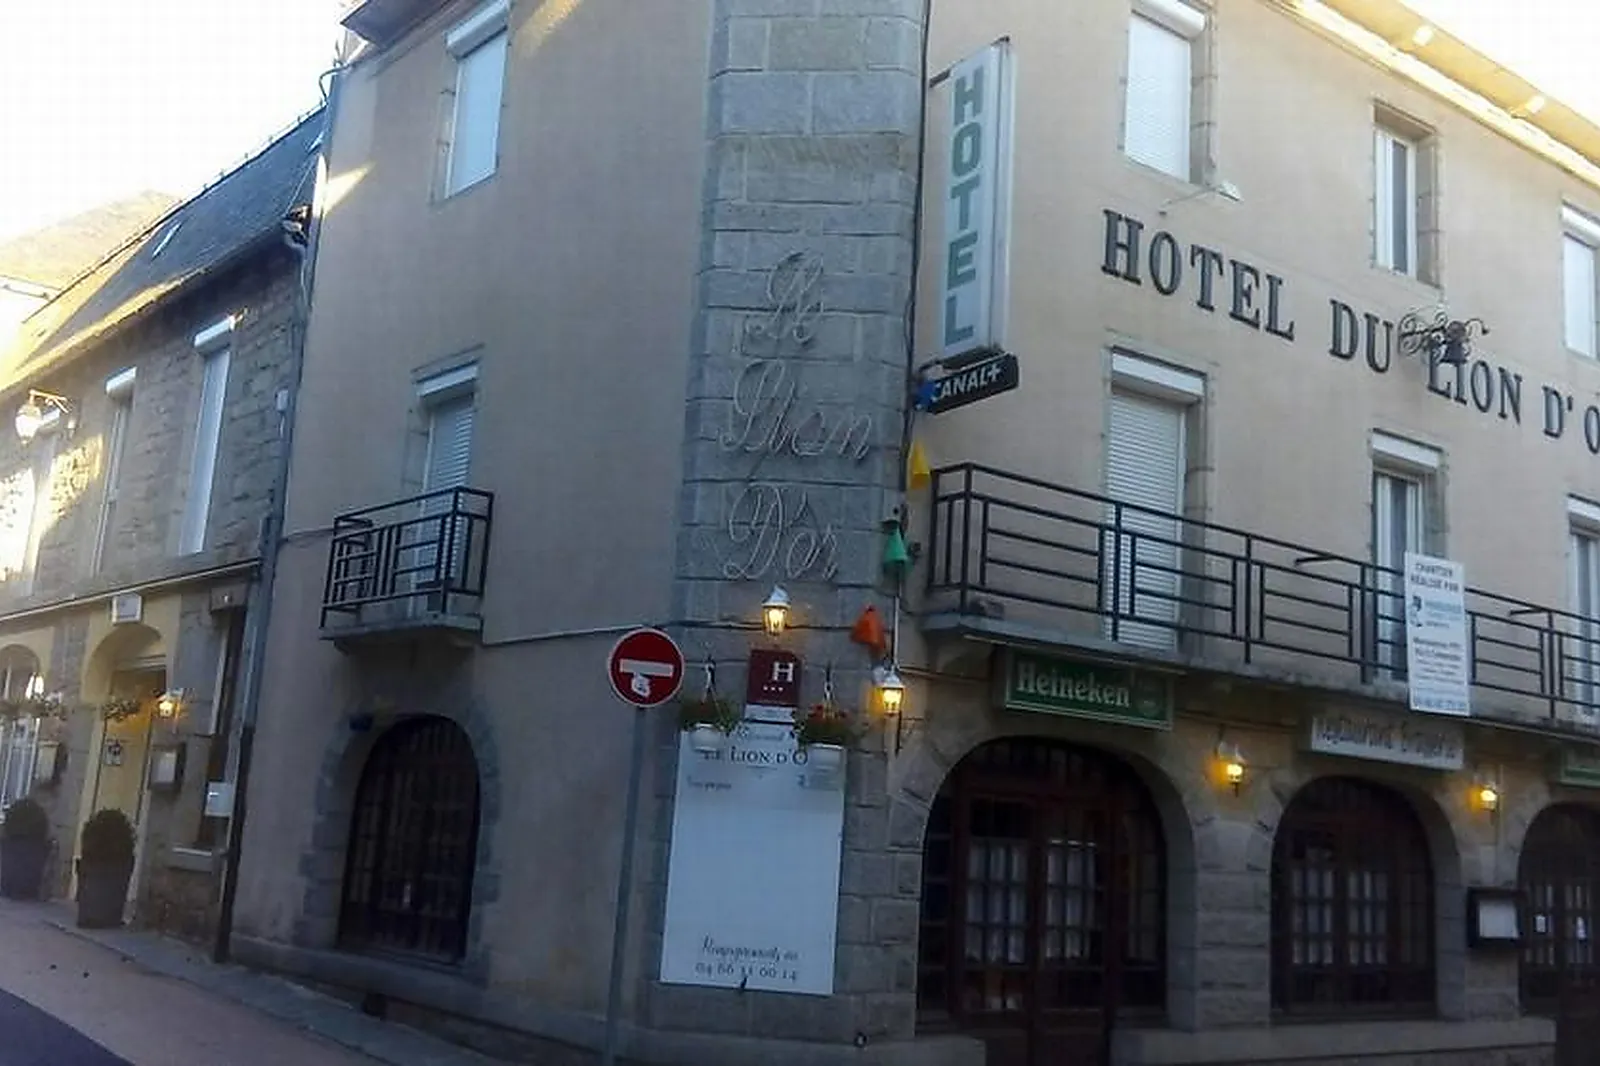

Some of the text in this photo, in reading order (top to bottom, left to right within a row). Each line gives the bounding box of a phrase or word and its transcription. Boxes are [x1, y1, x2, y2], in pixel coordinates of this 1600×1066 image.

[945, 66, 984, 347] HOTEL
[1101, 208, 1295, 341] HOTEL
[1329, 299, 1393, 373] DU
[1427, 338, 1522, 425] LION
[772, 661, 794, 682] H
[1016, 661, 1131, 708] Heineken
[730, 745, 771, 763] LION
[775, 747, 810, 766] D'O
